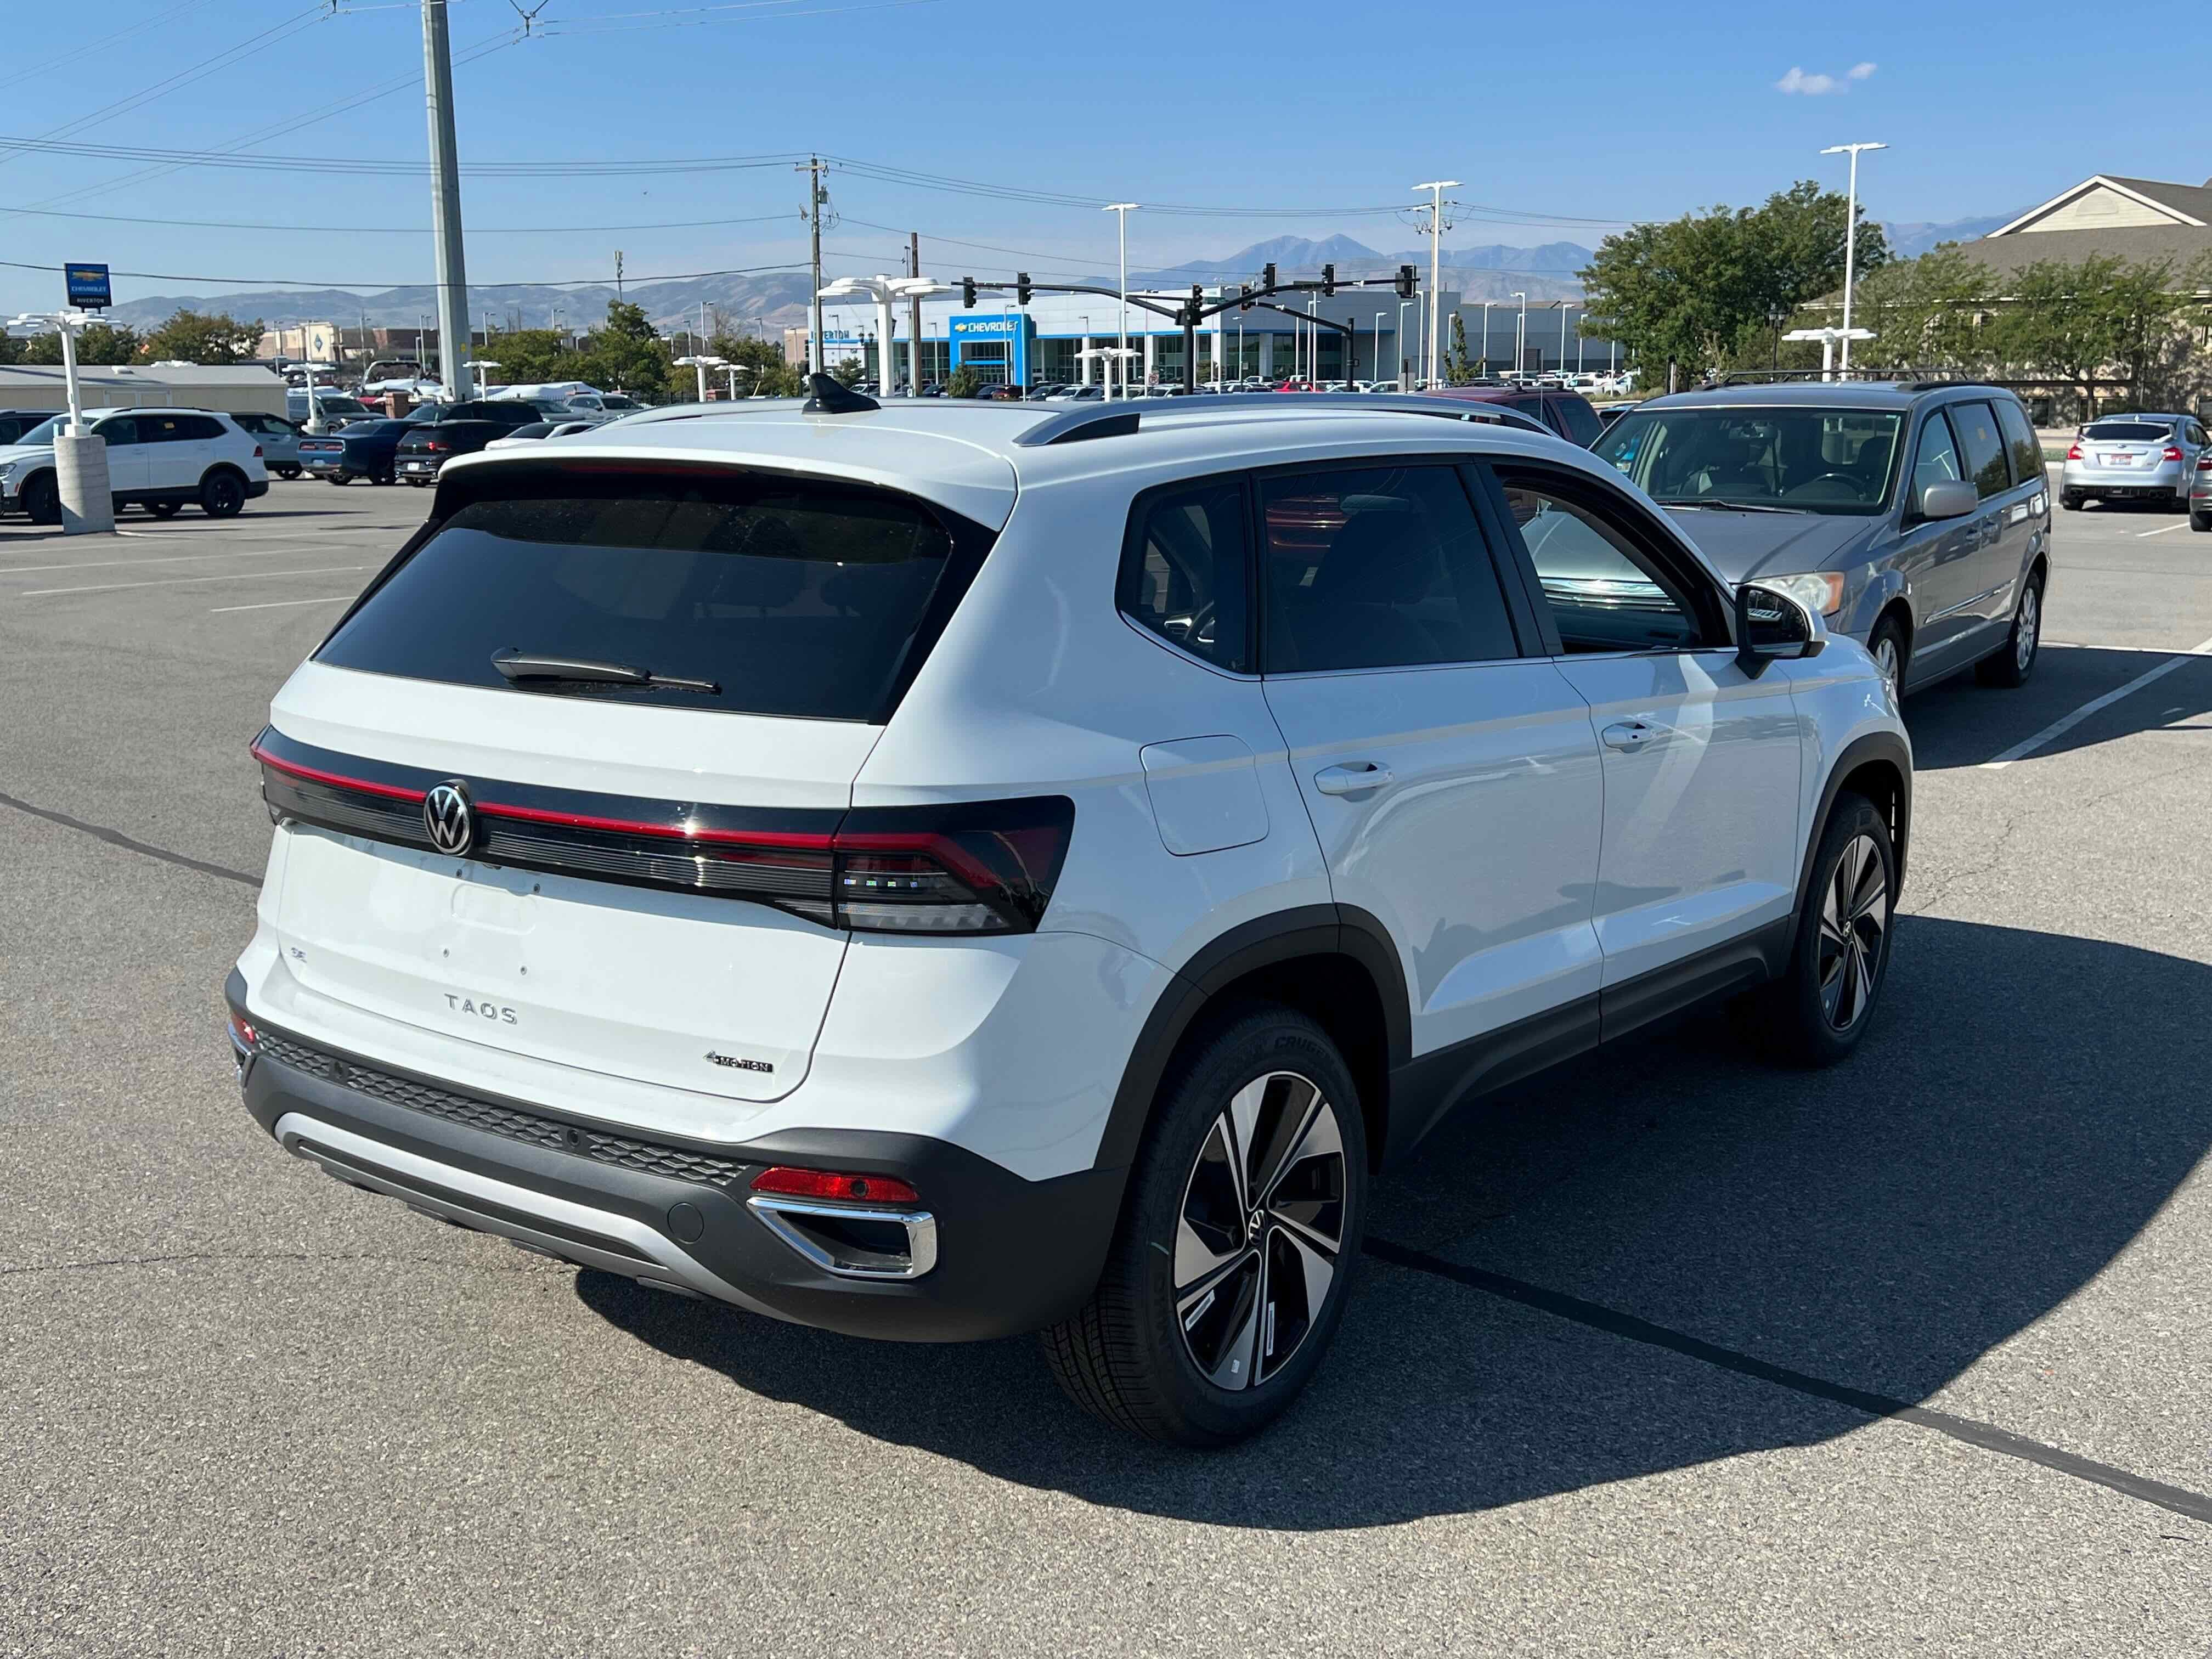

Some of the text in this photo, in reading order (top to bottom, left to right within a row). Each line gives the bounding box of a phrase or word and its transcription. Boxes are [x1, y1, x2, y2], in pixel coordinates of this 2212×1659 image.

[968, 320, 1019, 332] CHEVROLET
[444, 992, 517, 1025] TAOS
[703, 1050, 773, 1073] 4MOTION
